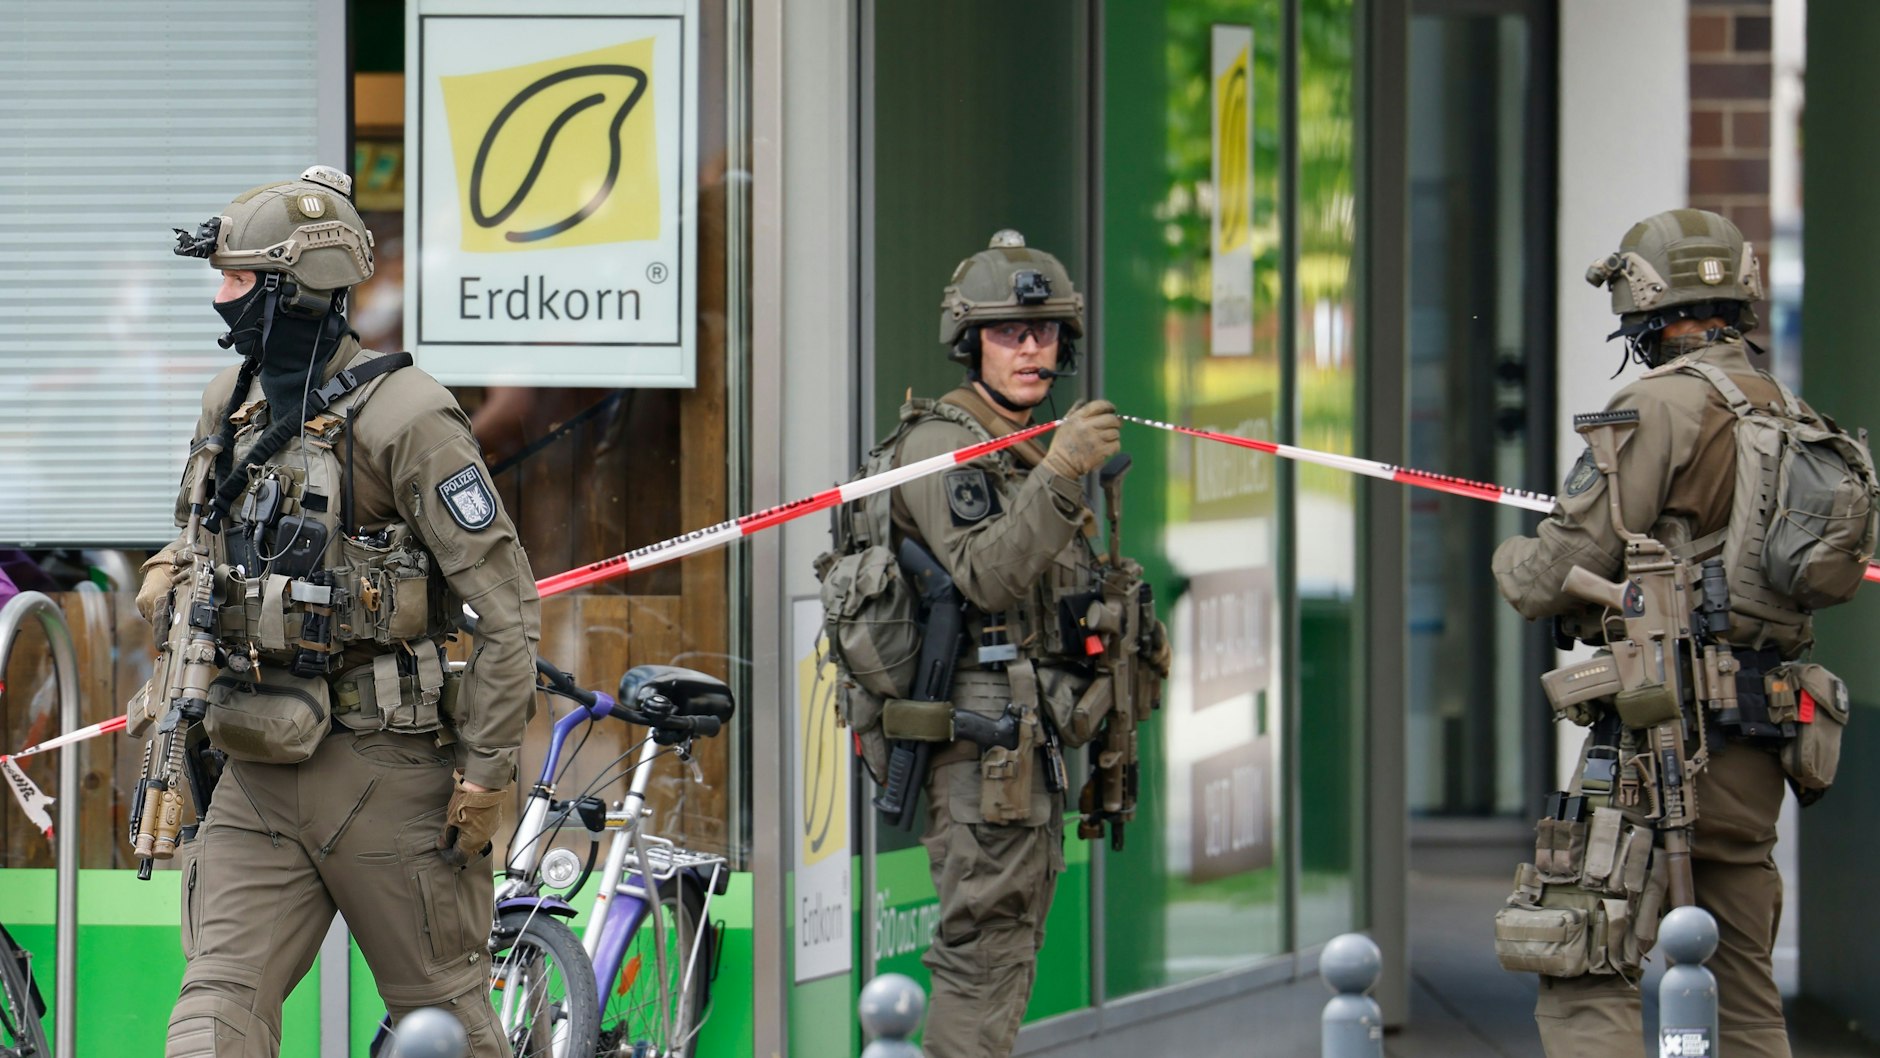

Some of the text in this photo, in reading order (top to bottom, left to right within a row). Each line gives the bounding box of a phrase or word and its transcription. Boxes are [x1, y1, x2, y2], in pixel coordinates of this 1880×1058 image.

[459, 275, 641, 321] Erdkorn
[443, 470, 477, 496] POLIZEI
[802, 891, 843, 948] Erdkorn
